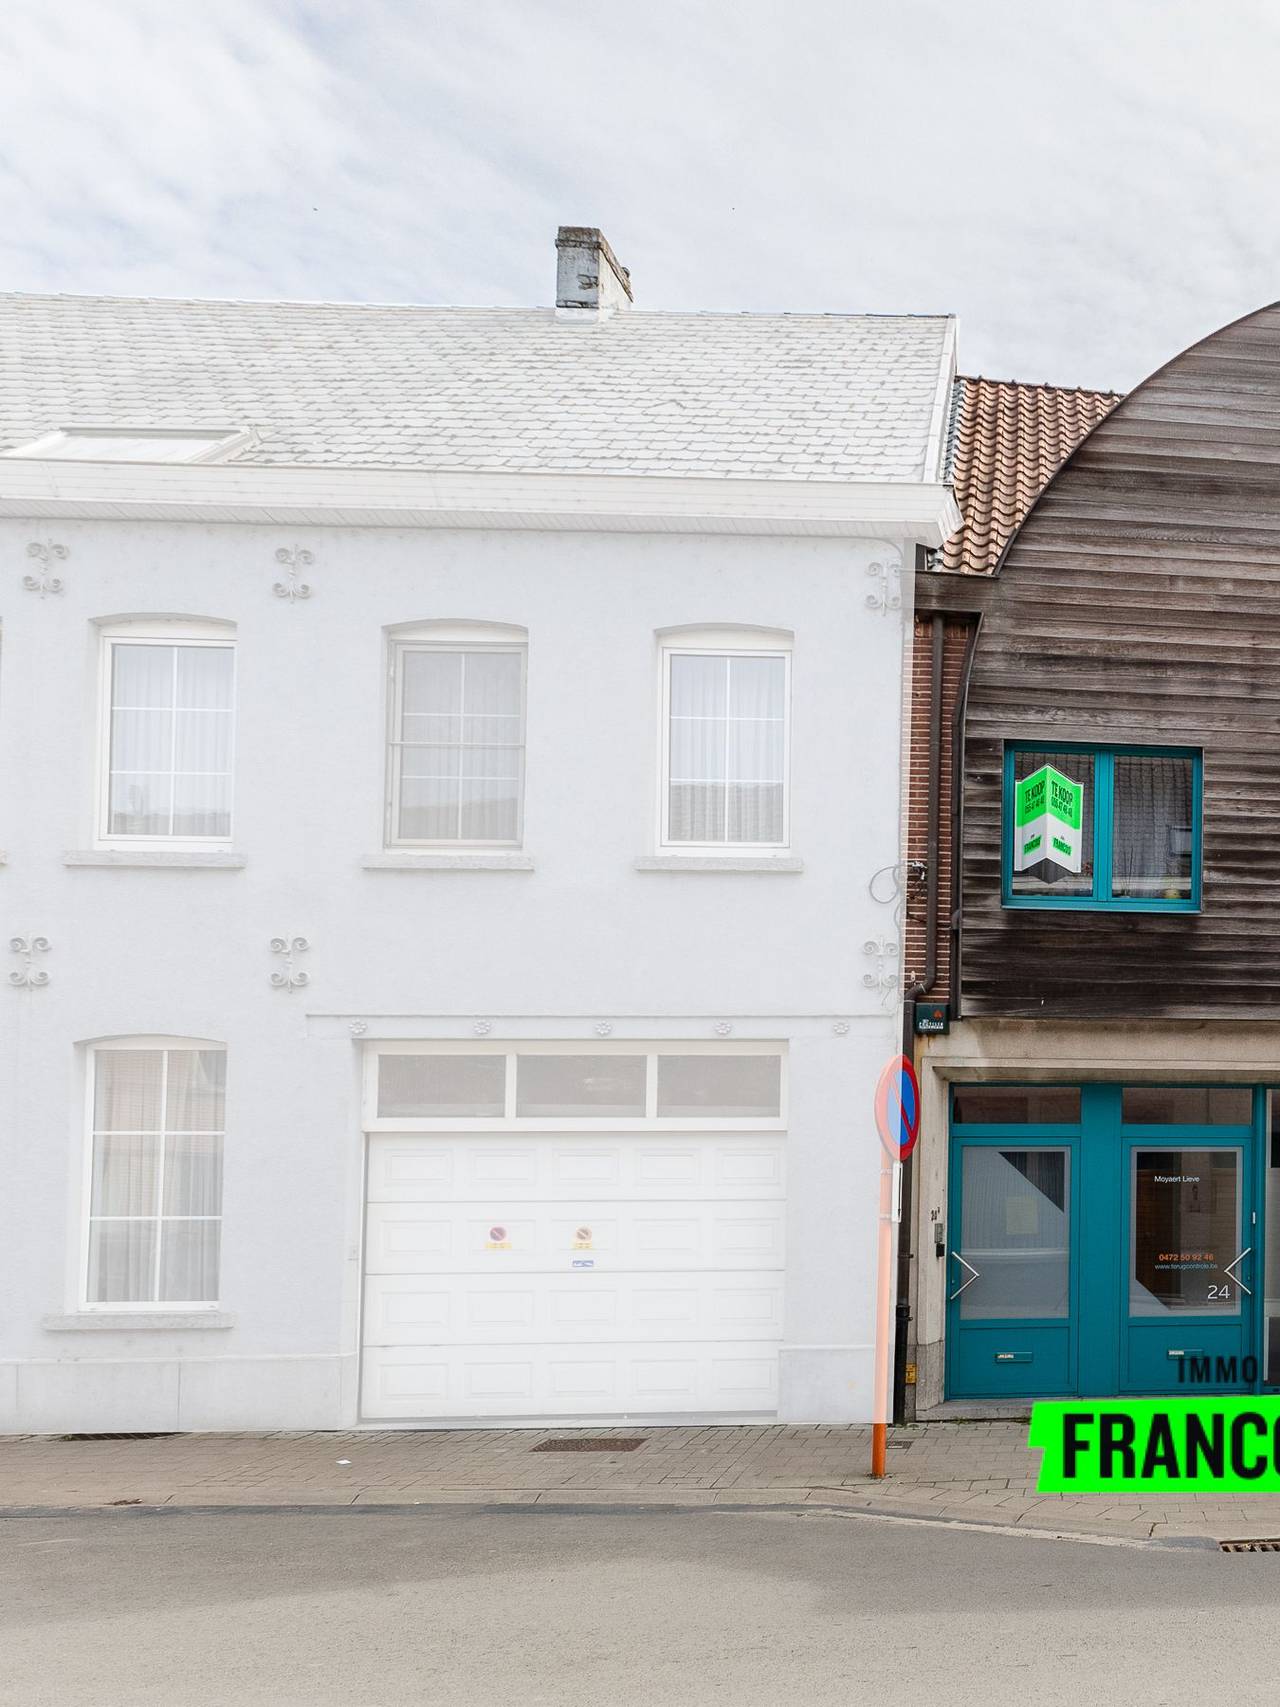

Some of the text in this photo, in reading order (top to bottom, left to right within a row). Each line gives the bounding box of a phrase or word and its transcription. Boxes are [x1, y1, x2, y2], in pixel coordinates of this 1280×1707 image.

[1154, 1175, 1181, 1183] Moyaert
[1158, 1253, 1179, 1261] 0472
[1207, 1284, 1231, 1299] 24
